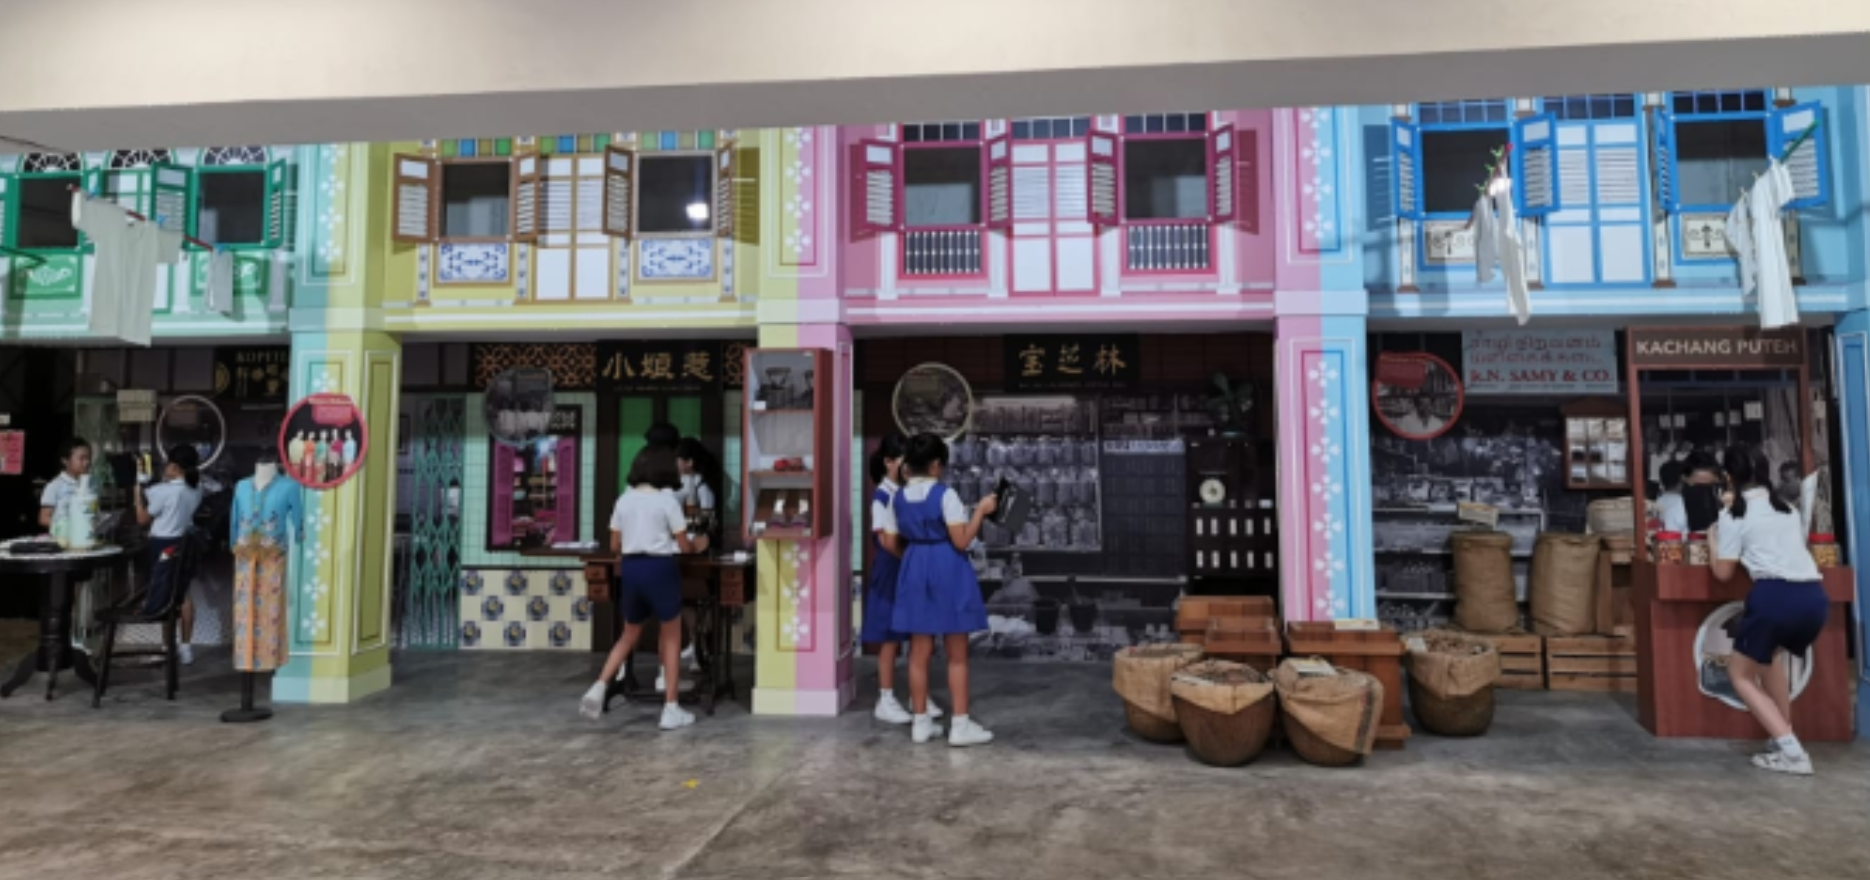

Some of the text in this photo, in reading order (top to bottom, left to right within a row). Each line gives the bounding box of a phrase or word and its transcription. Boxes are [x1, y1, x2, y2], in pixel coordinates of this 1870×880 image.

[1635, 337, 1798, 356] KACHANG PUTEH
[1510, 368, 1556, 382] SAMY
[1563, 369, 1579, 382] &
